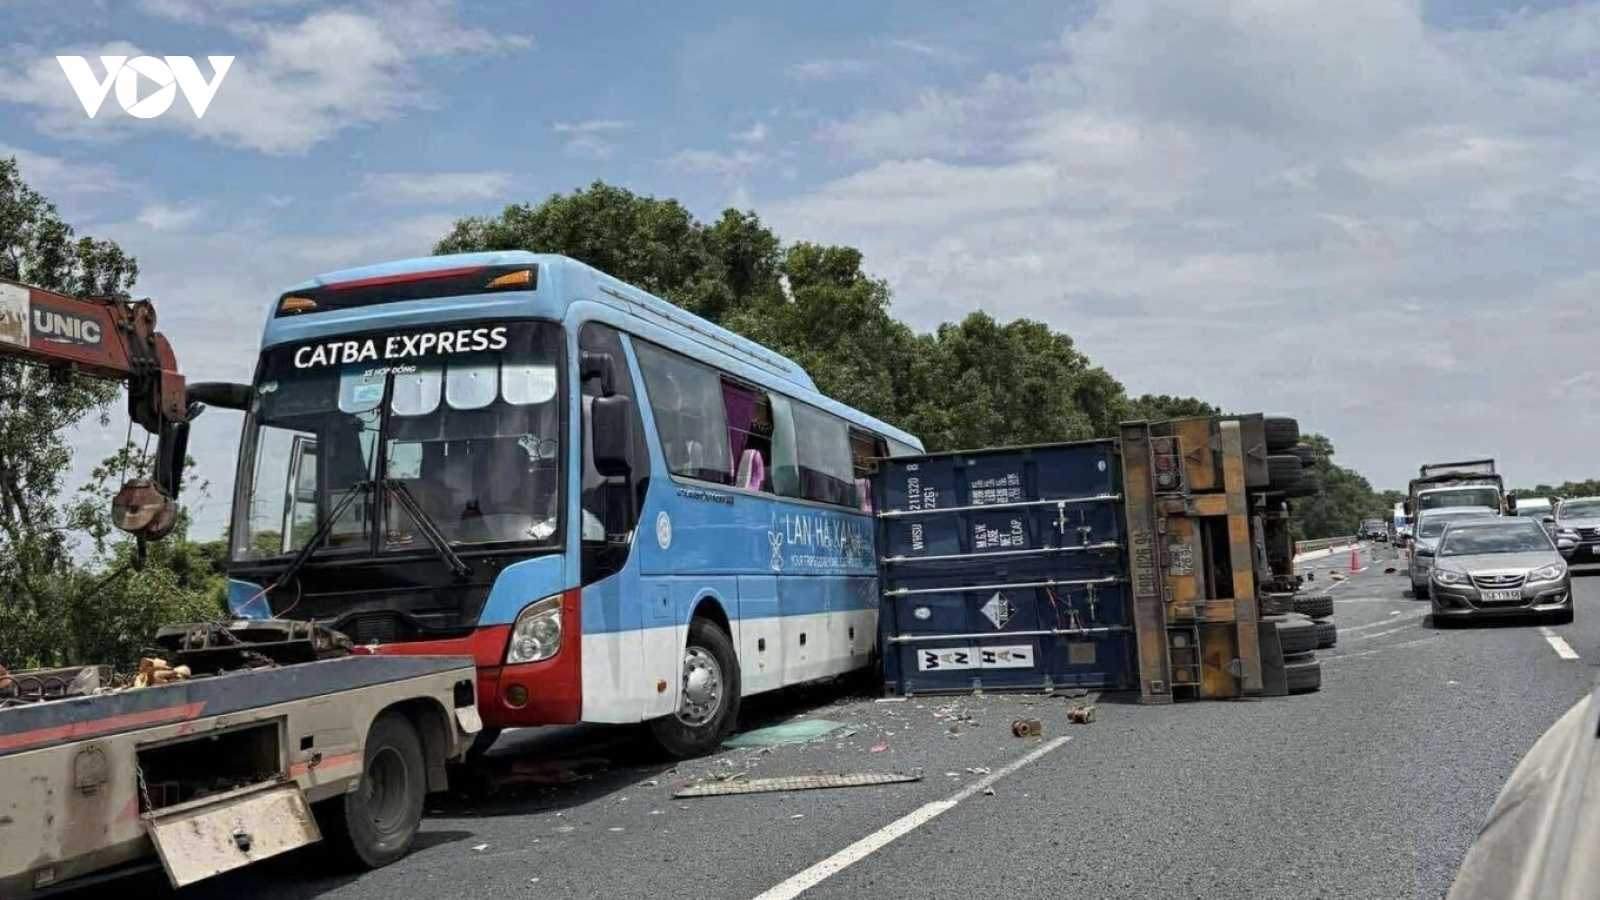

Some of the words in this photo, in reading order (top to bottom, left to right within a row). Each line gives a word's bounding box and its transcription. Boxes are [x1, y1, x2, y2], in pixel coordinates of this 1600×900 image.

[33, 309, 100, 343] UNIC
[294, 340, 377, 368] CATBA
[385, 327, 508, 358] EXPRESS
[906, 463, 919, 471] 8
[908, 477, 921, 510] 211320
[785, 514, 811, 546] LAN
[912, 523, 924, 550] WHSU
[1000, 533, 1011, 547] NET
[925, 651, 970, 670] WAN
[982, 650, 1027, 664] HAI
